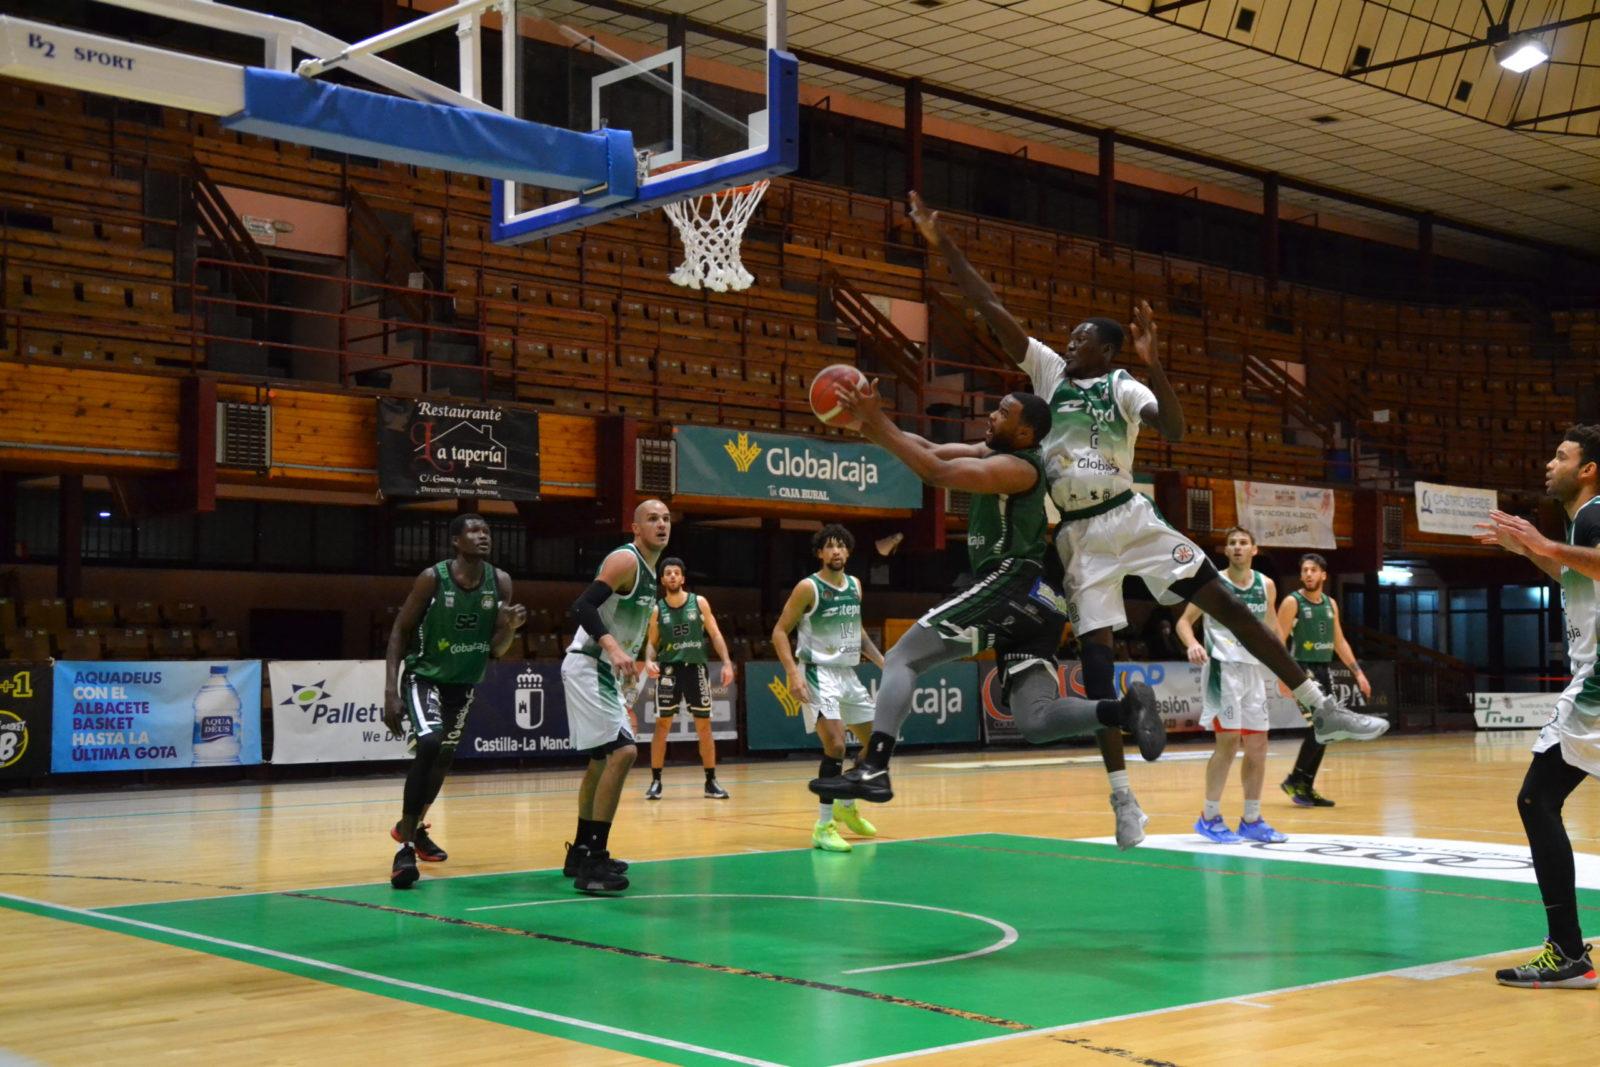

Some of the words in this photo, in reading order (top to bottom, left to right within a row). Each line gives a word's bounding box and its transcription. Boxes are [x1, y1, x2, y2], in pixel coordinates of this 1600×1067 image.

[74, 47, 136, 71] SPORT
[418, 401, 502, 421] Restaurante
[451, 445, 502, 468] tapería
[766, 448, 879, 491] Globalcaja
[779, 487, 801, 499] CAJA
[801, 489, 830, 501] RURAL
[455, 613, 480, 631] 52
[673, 624, 691, 637] 25
[841, 622, 855, 639] 14
[74, 671, 162, 685] AQUADEUS
[73, 686, 108, 700] CON
[111, 686, 128, 700] EL
[73, 702, 150, 715] ALBACETE
[1154, 696, 1190, 714] esión
[204, 717, 231, 726] AQUA
[312, 702, 386, 725] Pallet
[73, 717, 134, 730] BASKET
[204, 725, 231, 733] DEUS
[72, 733, 126, 747] HASTA
[129, 731, 150, 745] LA
[362, 731, 381, 742] We
[474, 736, 537, 752] Castilla-La
[540, 735, 576, 750] Manc
[72, 745, 131, 762] ÚLTIMA
[135, 746, 178, 759] GOTA
